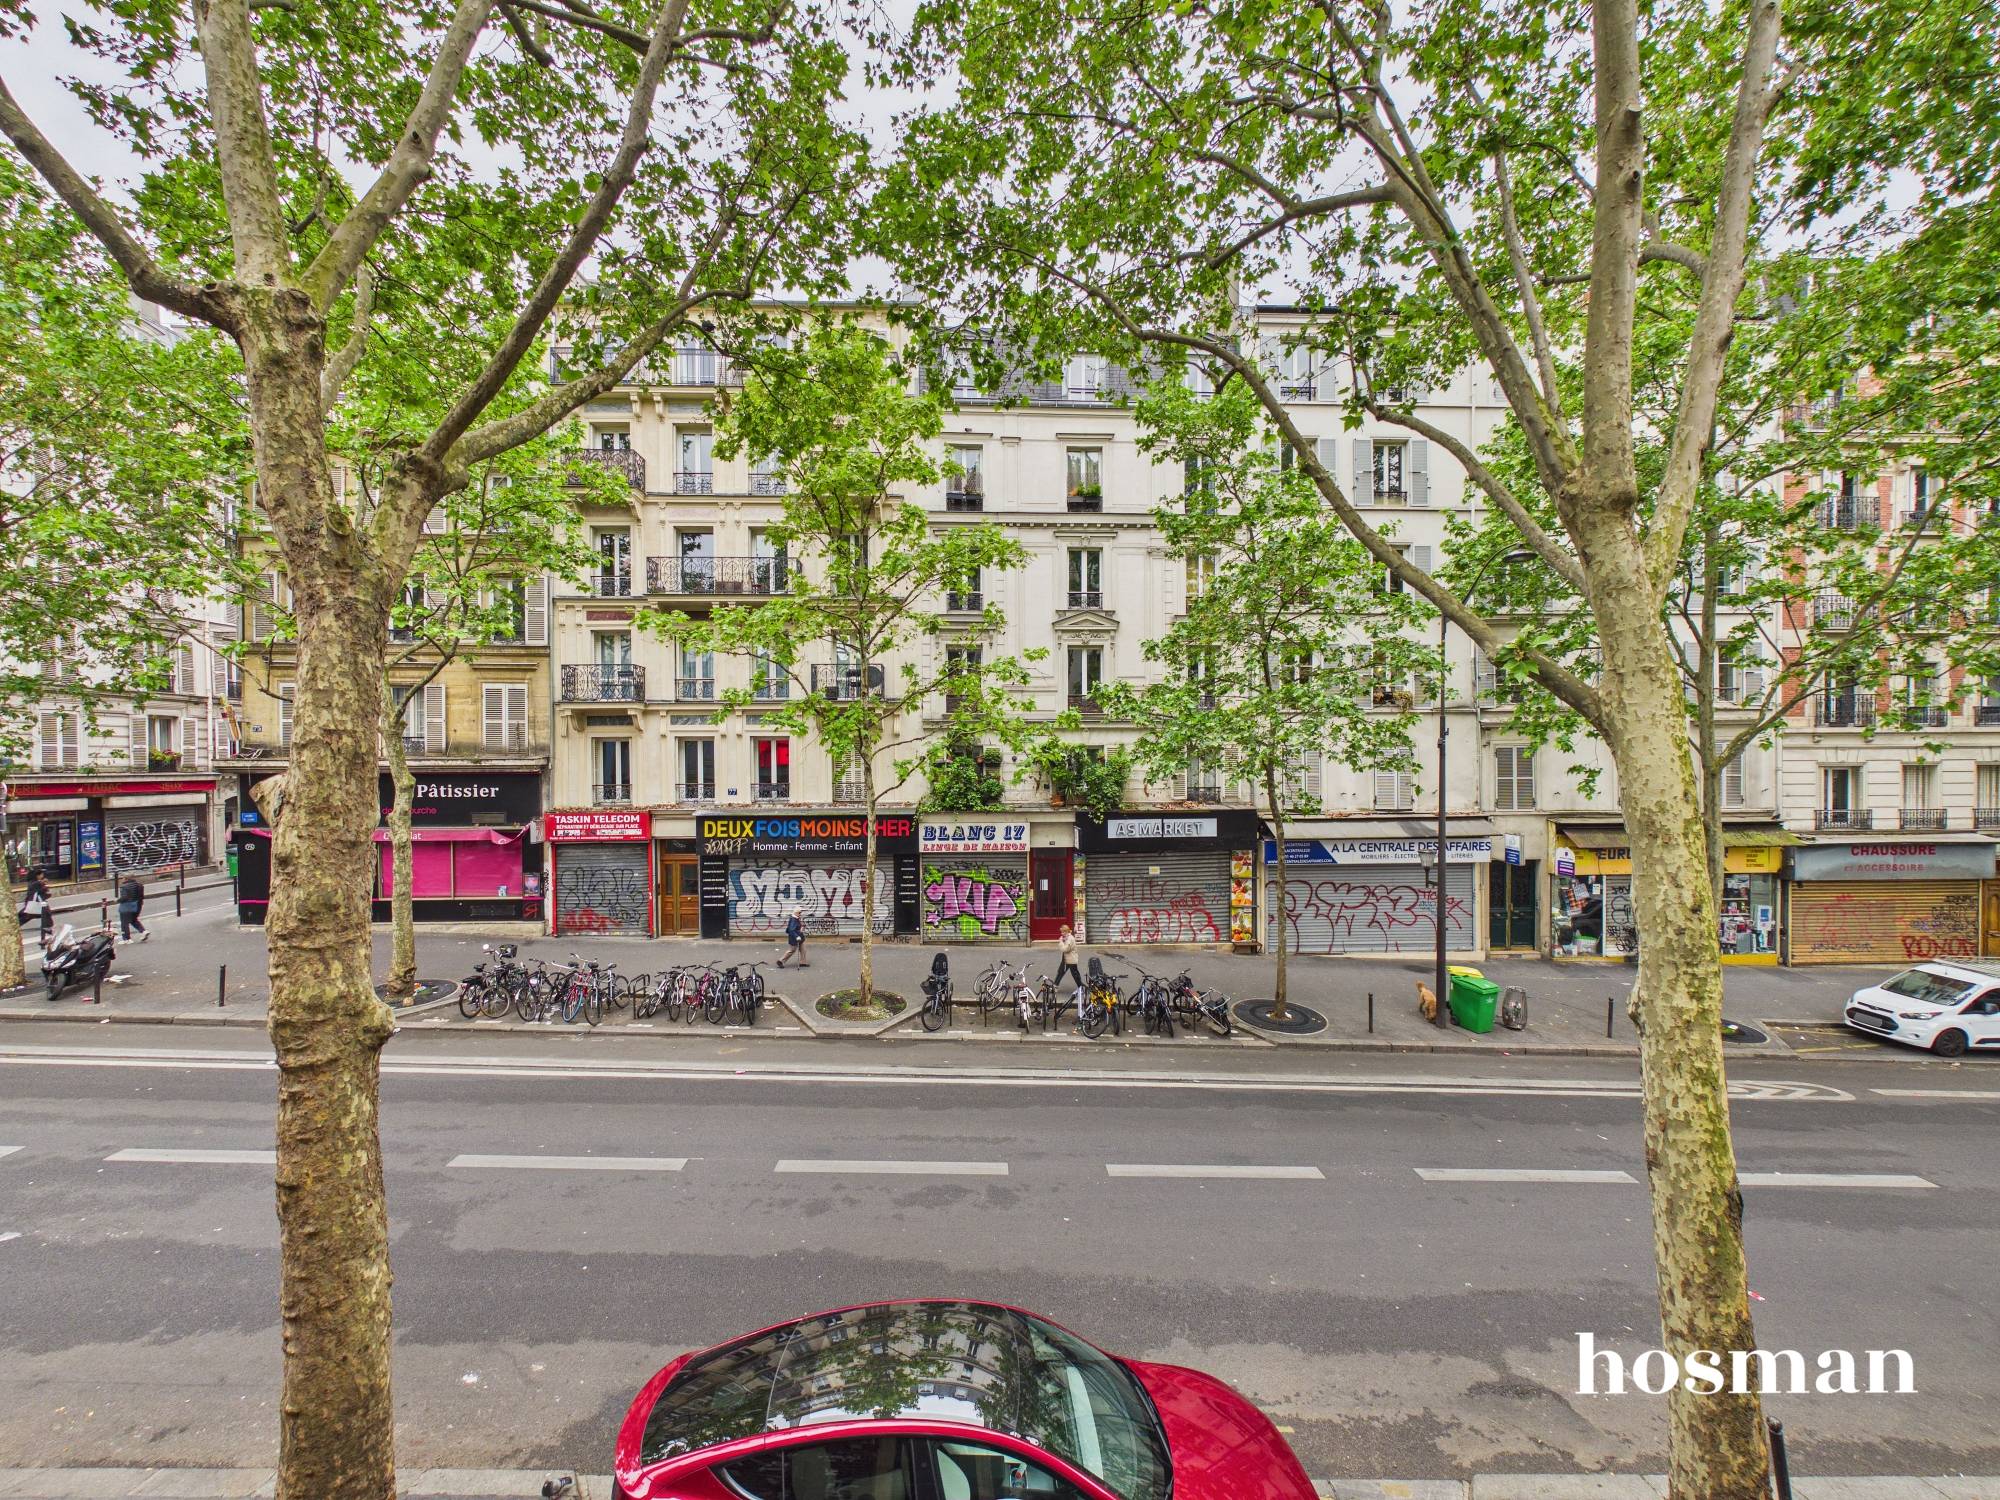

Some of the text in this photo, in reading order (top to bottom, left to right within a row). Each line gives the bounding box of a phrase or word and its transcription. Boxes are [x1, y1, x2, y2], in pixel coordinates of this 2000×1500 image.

[417, 784, 499, 798] Pâtissier
[555, 815, 640, 824] TASKIN TELECOM
[704, 820, 754, 838] DEUX
[755, 820, 801, 838] FOIS
[801, 820, 863, 838] MOINS
[923, 825, 1026, 841] BLANC 17
[1116, 822, 1204, 836] AS MARKET
[753, 842, 788, 851] Homme
[795, 842, 828, 851] Femme
[835, 841, 863, 850] Enfant
[923, 843, 1027, 852] LINGE DE MAISON
[1331, 843, 1339, 852] A
[1343, 843, 1356, 852] LA
[1359, 842, 1415, 852] CENTRALE
[1418, 842, 1438, 851] DES
[1851, 844, 1937, 856] CHAUSSURE
